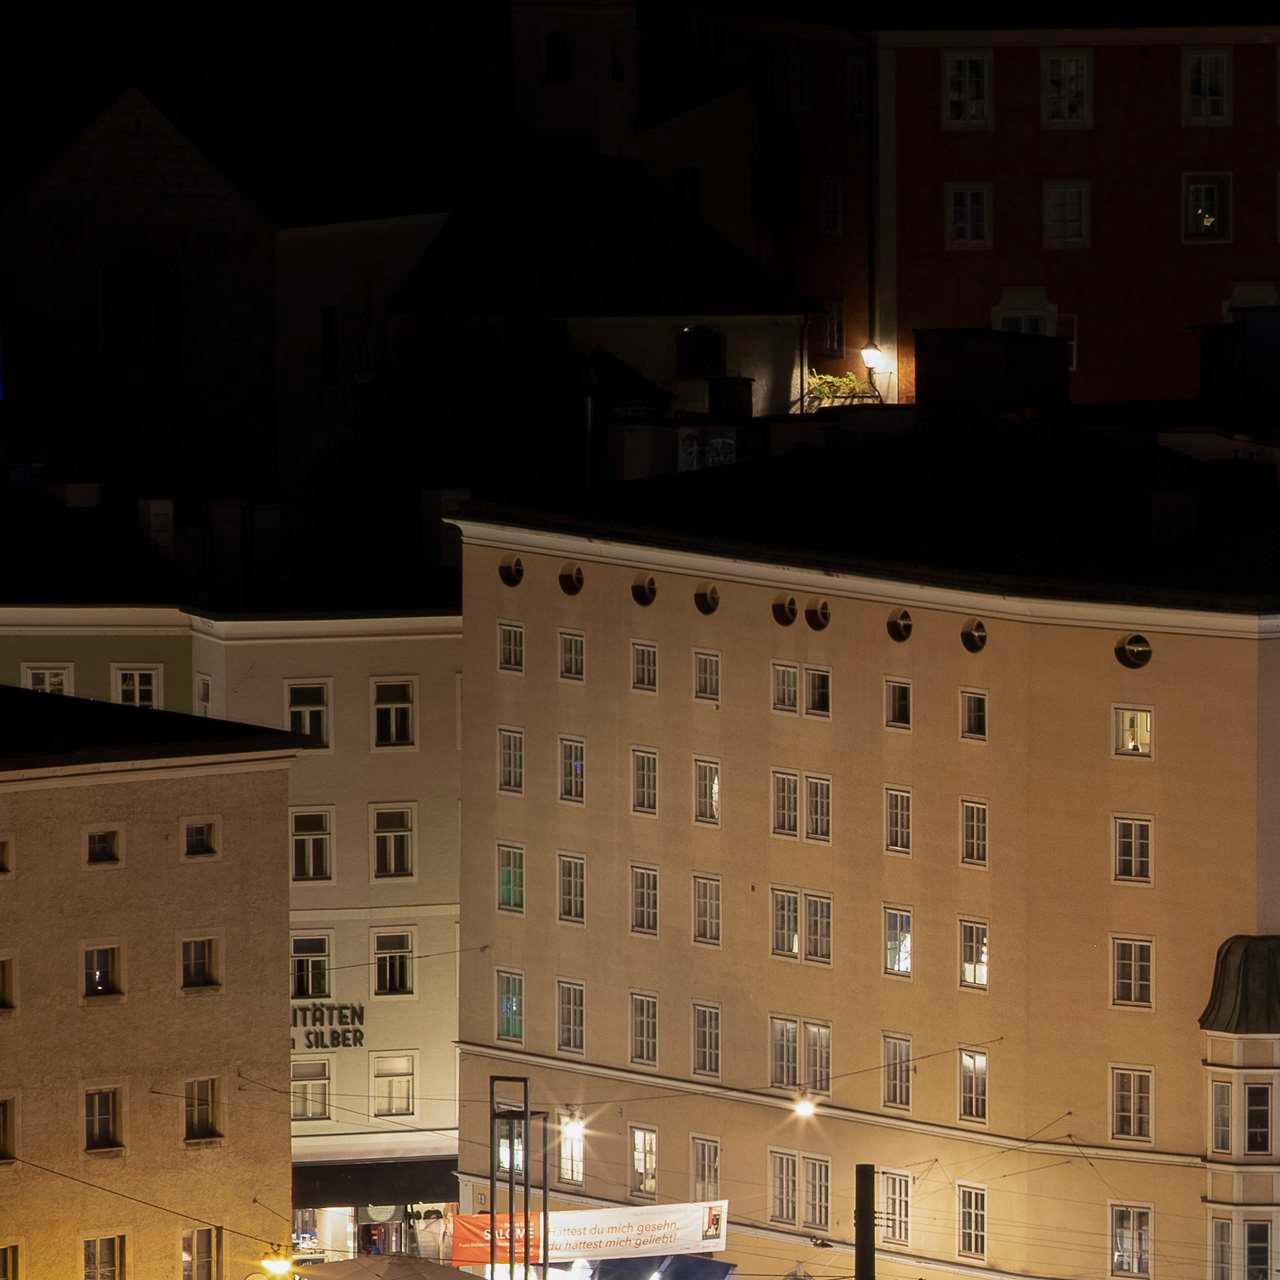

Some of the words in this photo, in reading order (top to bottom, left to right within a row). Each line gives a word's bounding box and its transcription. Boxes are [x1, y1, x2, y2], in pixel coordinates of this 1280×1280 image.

[304, 1029, 364, 1048] SILBER
[607, 1221, 634, 1235] mich
[605, 1235, 632, 1248] mich
